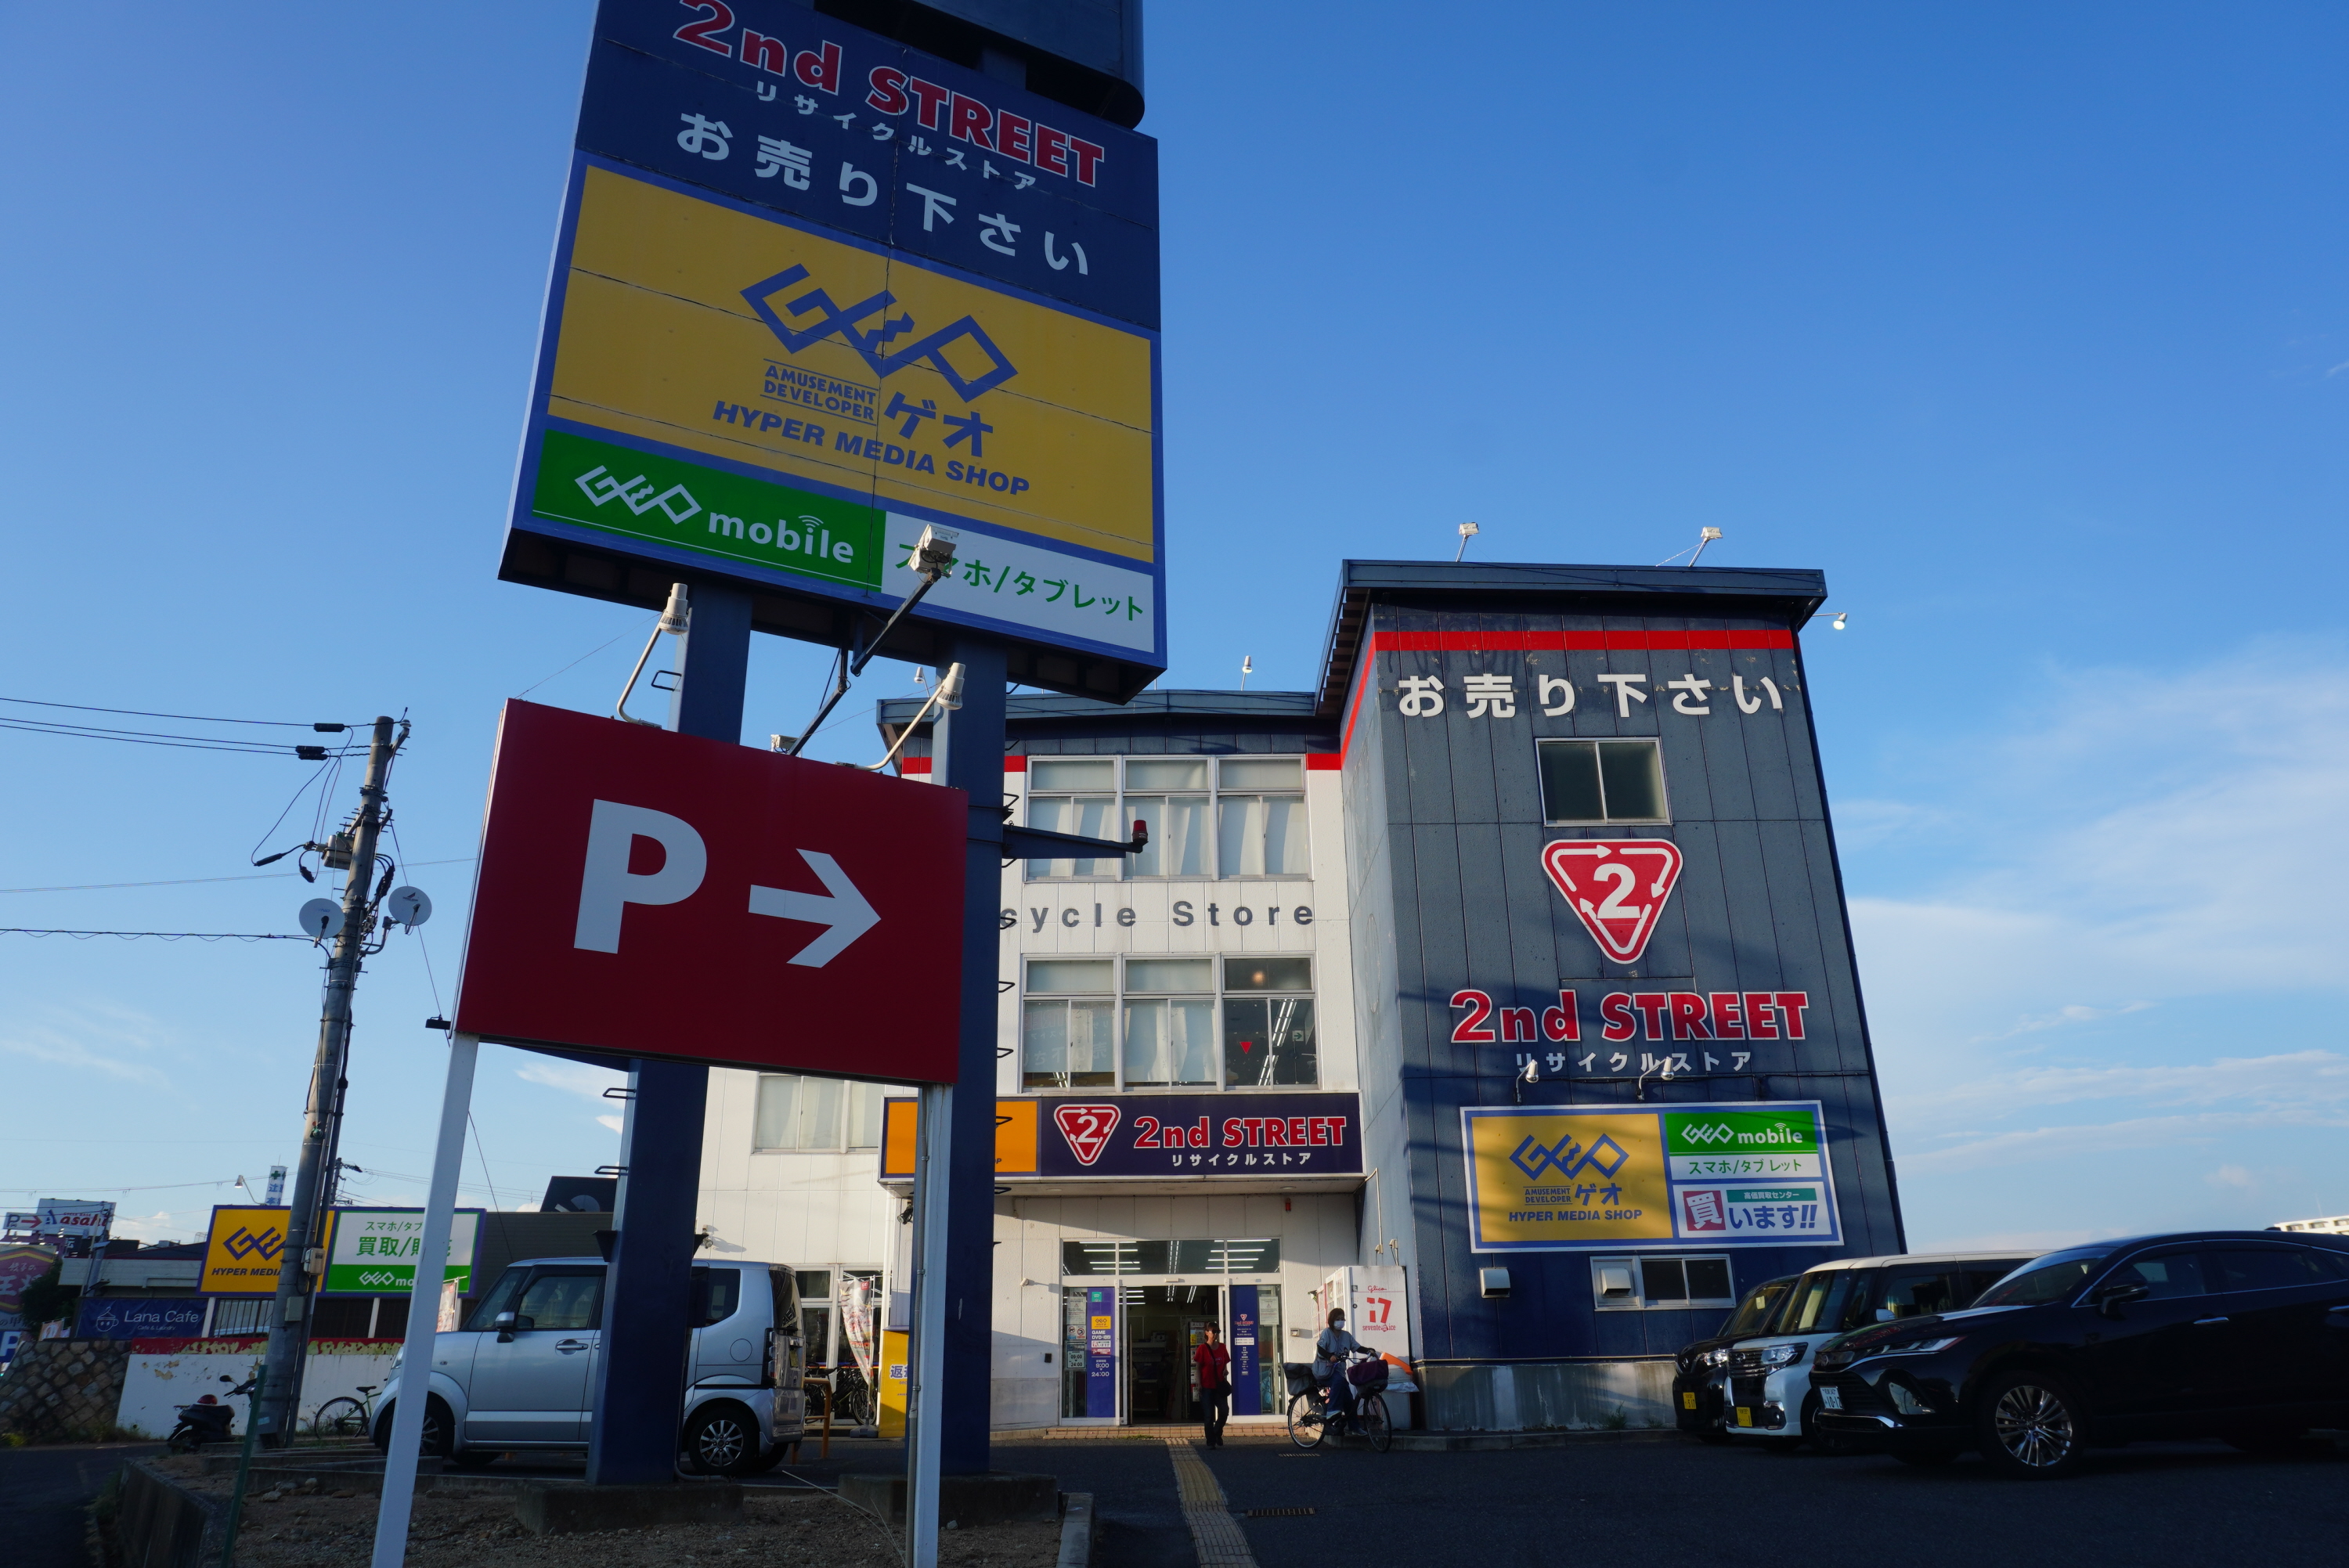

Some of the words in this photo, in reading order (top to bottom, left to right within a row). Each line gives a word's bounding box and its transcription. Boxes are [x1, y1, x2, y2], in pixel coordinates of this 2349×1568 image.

[673, 0, 843, 95] 2nd
[865, 65, 1104, 188] STREET
[757, 80, 1037, 190] リサイクルストア
[677, 112, 1089, 276] お売り下さい
[764, 380, 875, 421] DEVELOPER
[765, 365, 876, 406] AMUSEMENT
[883, 391, 993, 458] ゲオ
[713, 400, 825, 446] HYPER
[834, 431, 936, 475] MEDIA
[945, 460, 1030, 496] SHOP
[708, 512, 854, 564] mobile
[1398, 673, 1783, 719] お売り下さい
[573, 798, 707, 954] P
[1593, 863, 1641, 919] 2
[1172, 900, 1314, 928] Store
[1449, 989, 1581, 1044] 2nd
[1600, 990, 1809, 1042] STREET
[1516, 1051, 1751, 1072] リサイクルストア
[1077, 1116, 1098, 1143] 2
[1133, 1116, 1210, 1149] 2nd
[1221, 1116, 1347, 1148] STREET
[1737, 1125, 1803, 1144] mobile
[1172, 1152, 1311, 1166] リサイクルストア
[1689, 1158, 1802, 1175] スマホ/タブレット
[1525, 1188, 1571, 1196] AMUSEMENT
[1575, 1183, 1622, 1206] ゲオ
[1744, 1191, 1799, 1200] 高価買取センター
[1509, 1211, 1553, 1222] HYPER
[1557, 1210, 1600, 1221] MEDIA
[1604, 1209, 1643, 1220] SHOP
[211, 1267, 247, 1276] HYPER
[1367, 1285, 1387, 1293] Glico
[124, 1310, 161, 1322] Lana
[164, 1310, 199, 1322] Cafe
